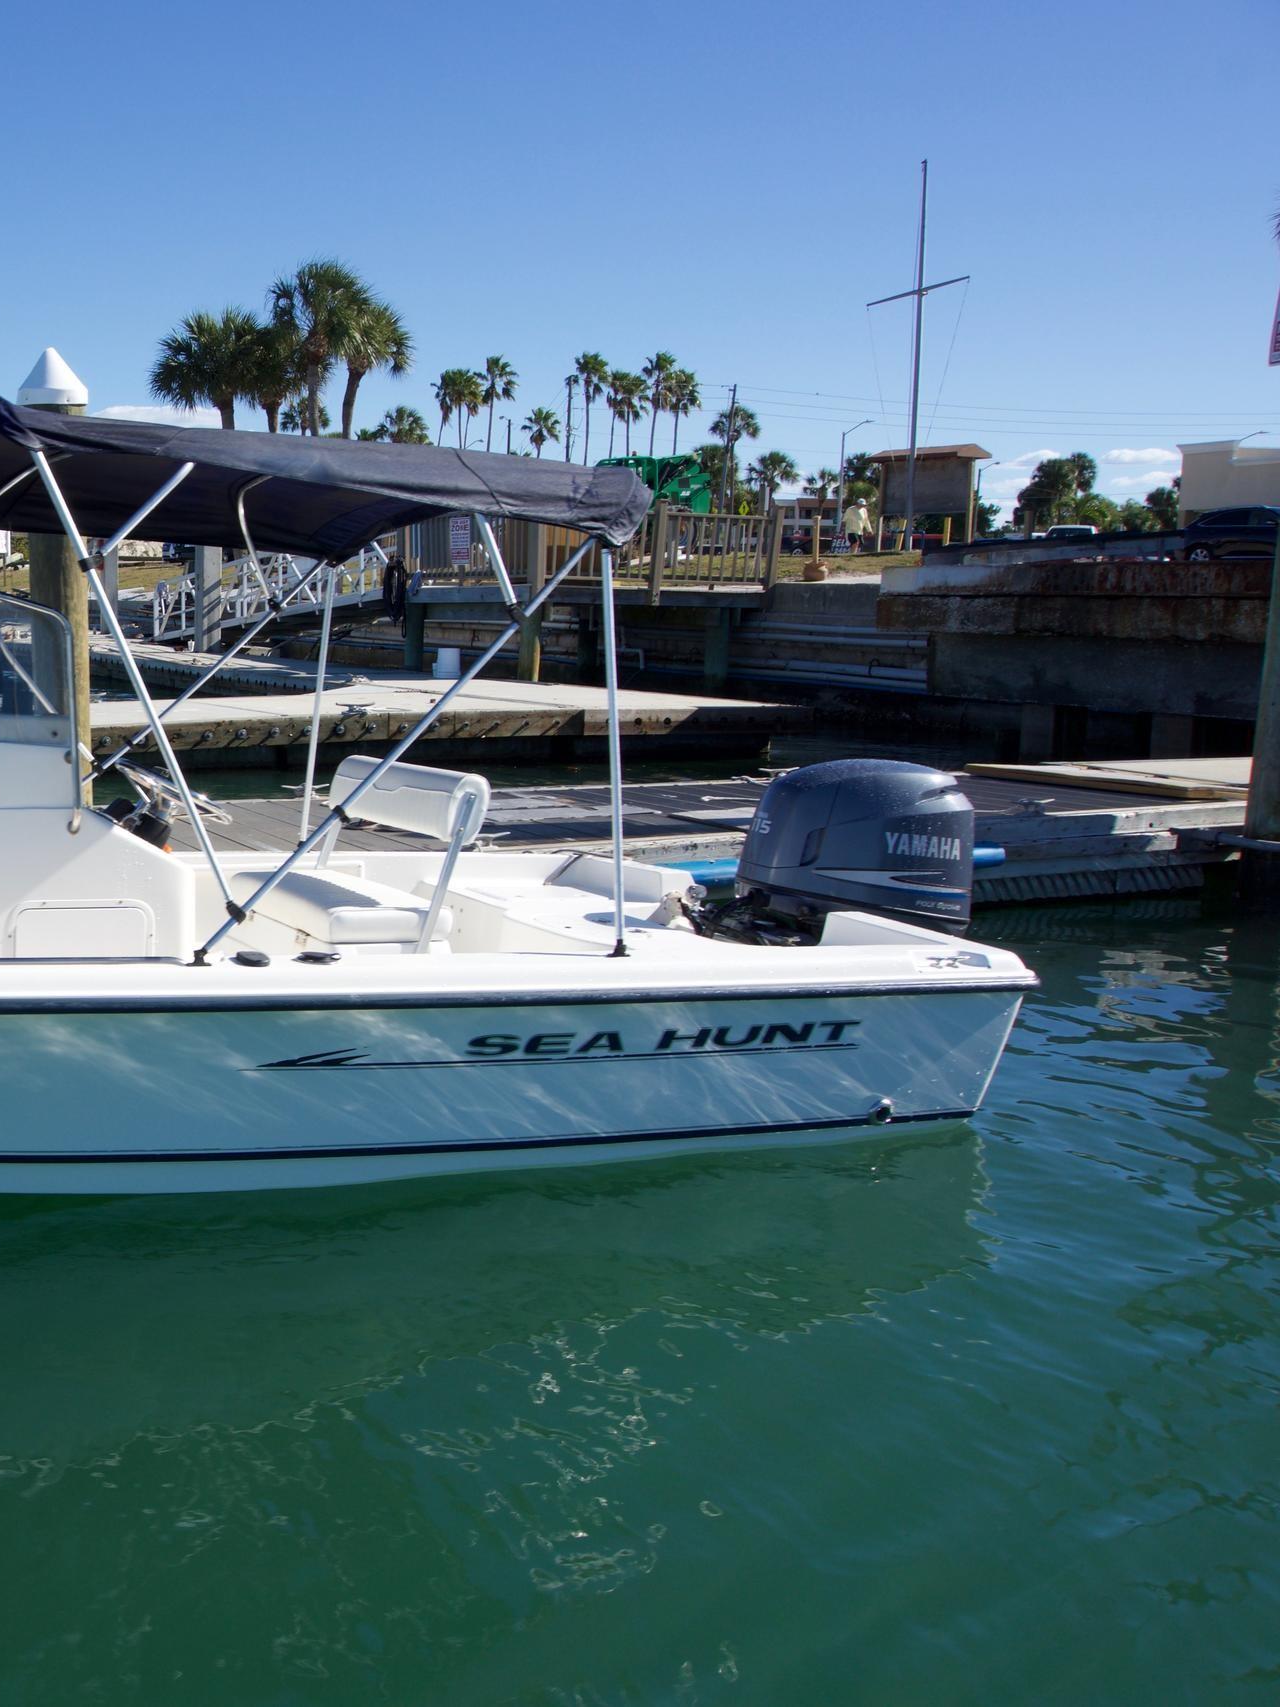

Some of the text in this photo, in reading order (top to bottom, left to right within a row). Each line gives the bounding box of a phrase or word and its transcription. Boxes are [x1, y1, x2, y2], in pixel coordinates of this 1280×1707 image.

[885, 831, 960, 861] YAMAHA
[465, 1020, 862, 1057] SEA HUNT
